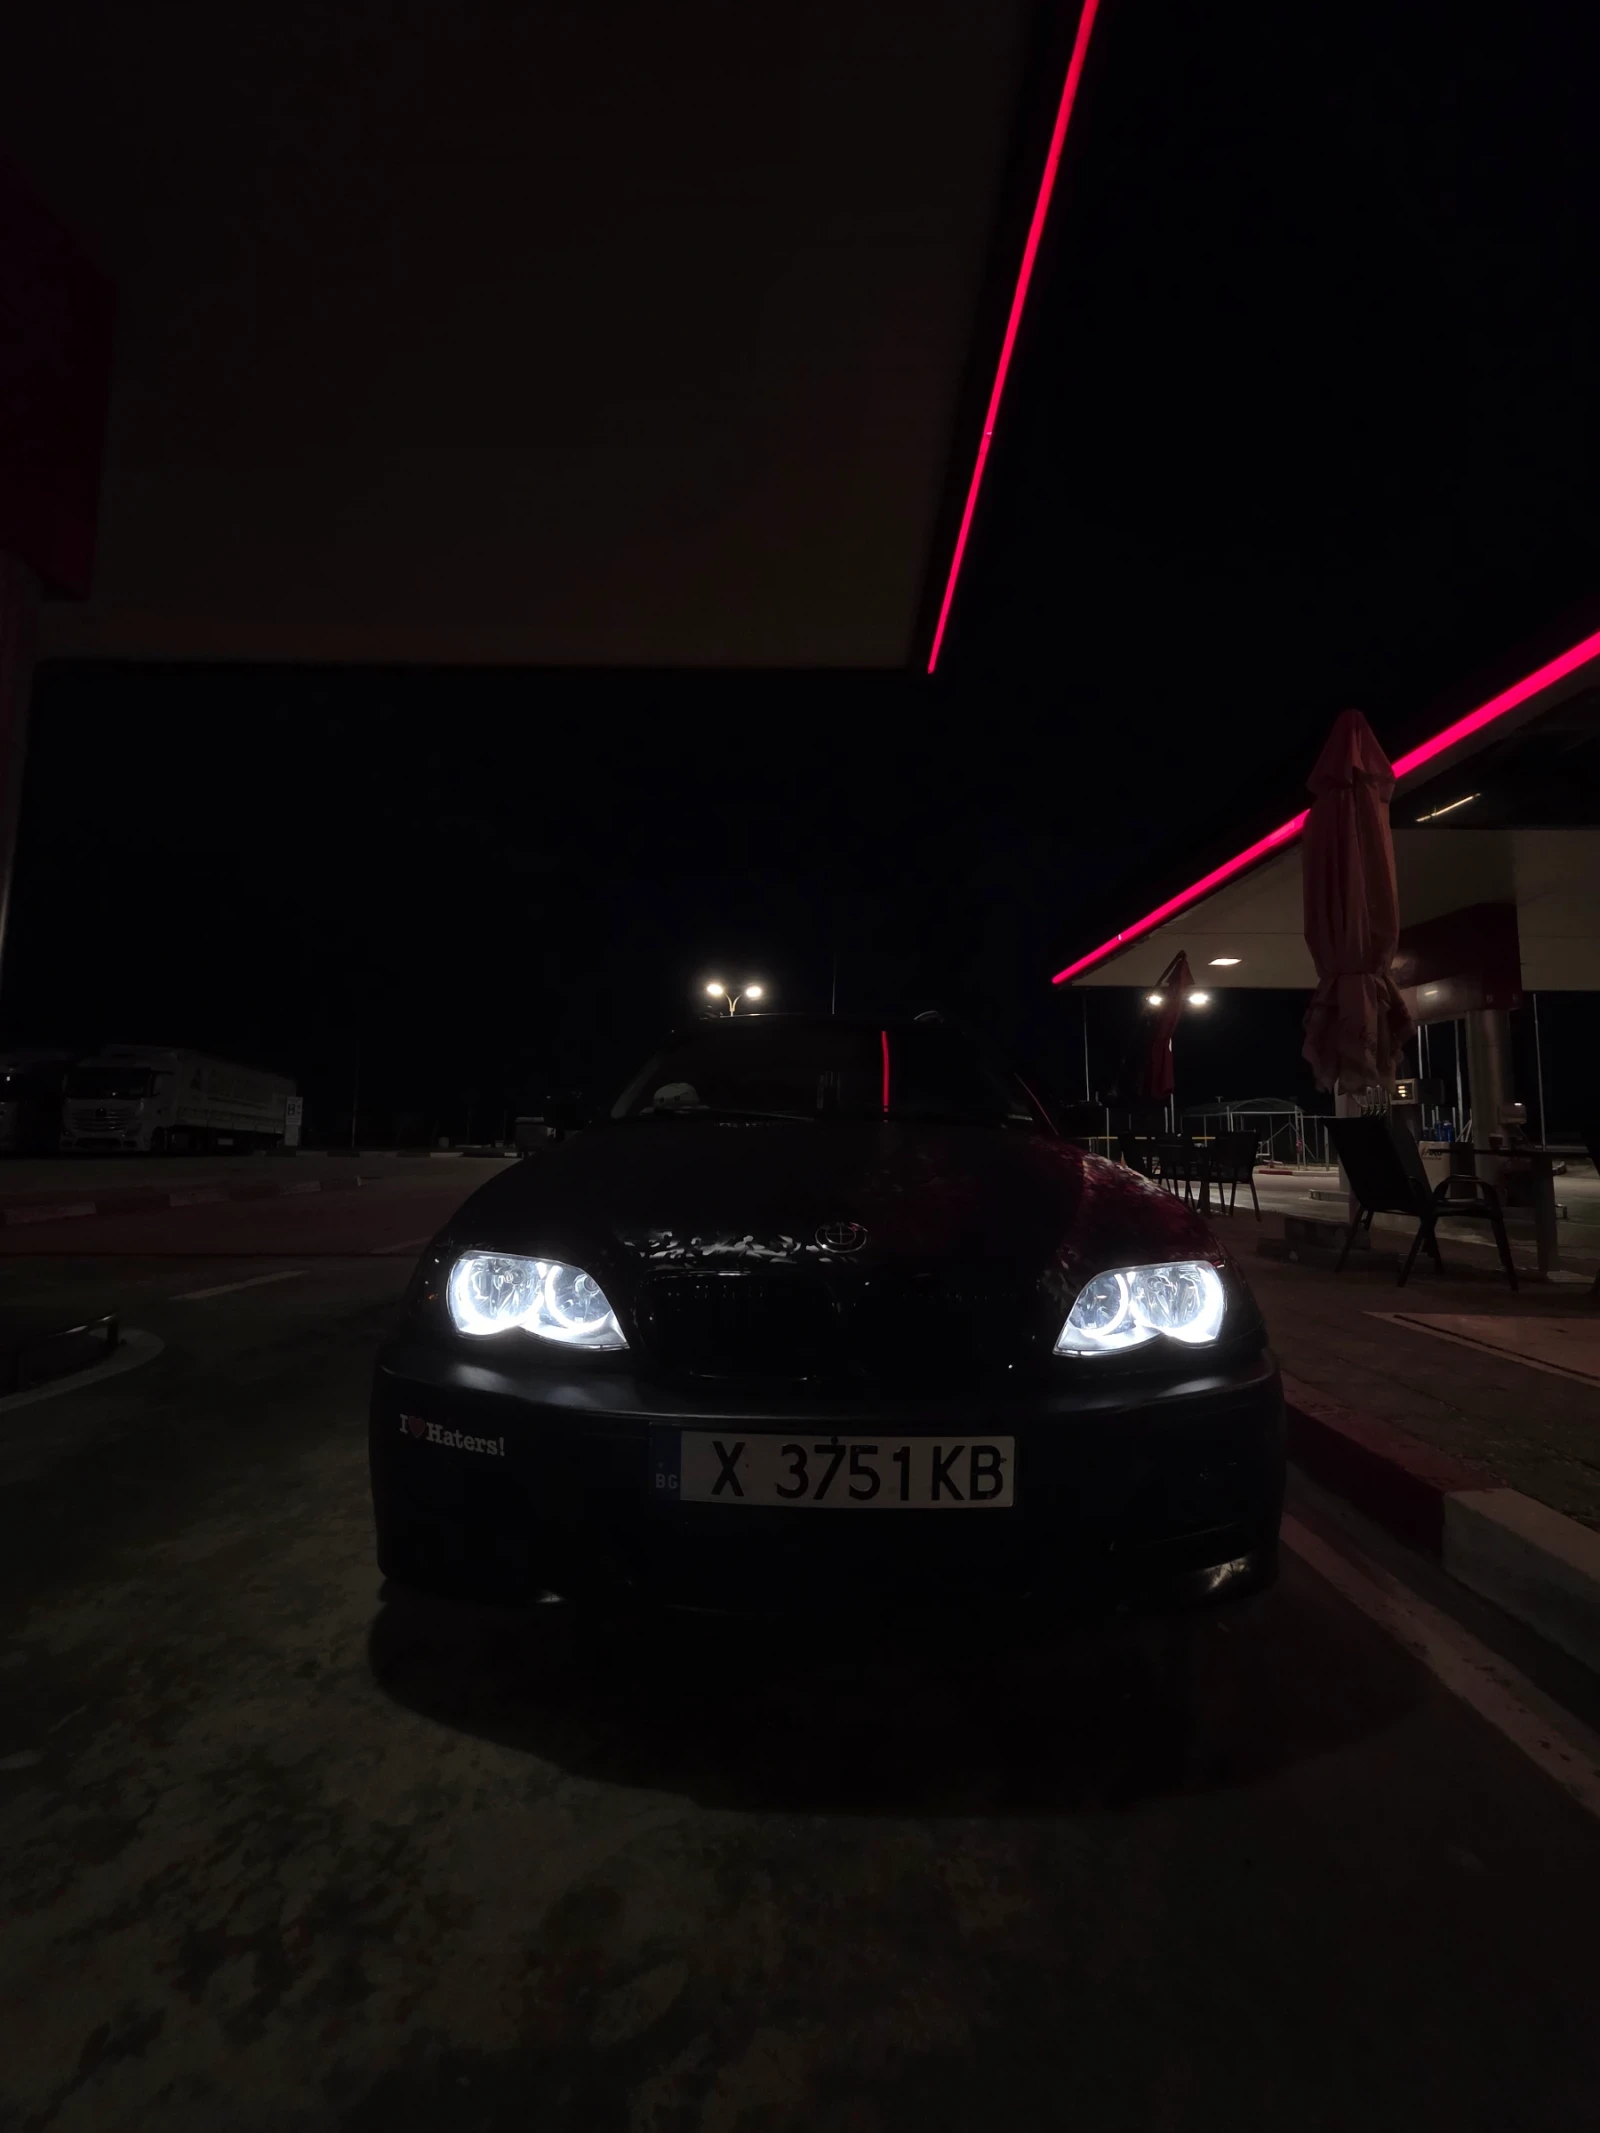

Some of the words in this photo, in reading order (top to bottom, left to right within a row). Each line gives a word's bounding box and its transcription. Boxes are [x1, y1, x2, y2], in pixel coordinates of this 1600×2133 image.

[399, 1413, 409, 1435] I
[425, 1421, 506, 1457] Haters!
[655, 1472, 680, 1489] BG
[711, 1441, 746, 1497] X
